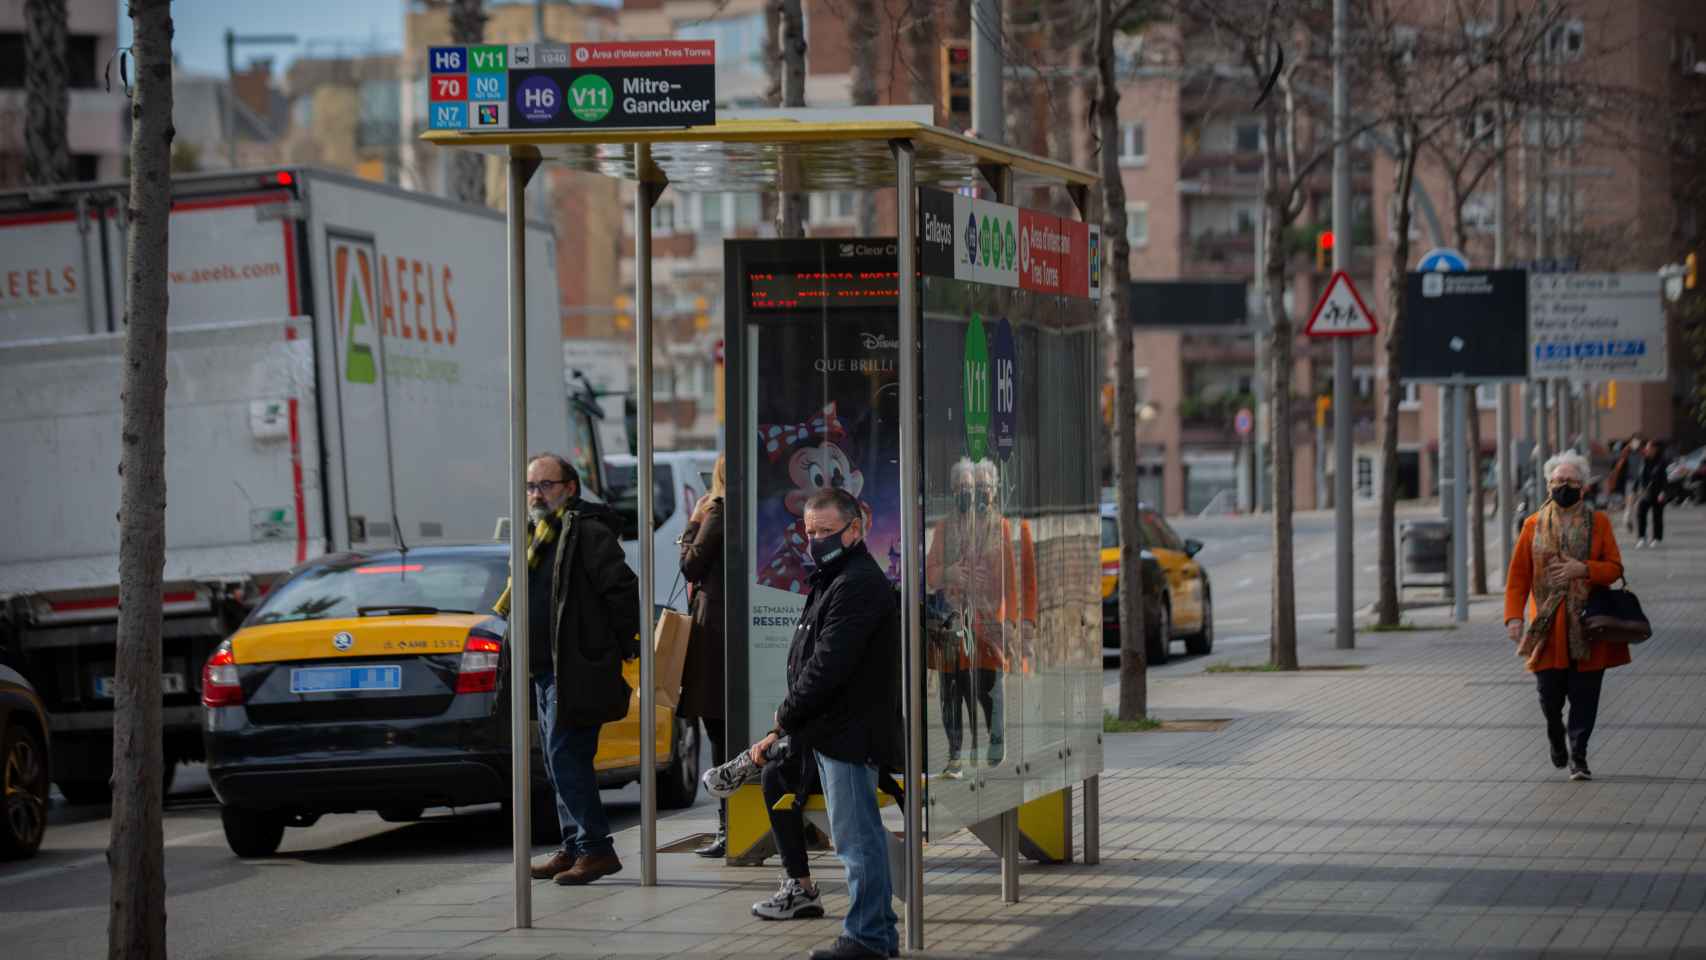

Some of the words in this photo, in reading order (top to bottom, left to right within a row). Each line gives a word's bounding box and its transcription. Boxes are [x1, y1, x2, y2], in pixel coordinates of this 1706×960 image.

[435, 52, 461, 69] H6
[473, 51, 504, 68] V11
[437, 79, 460, 97] 70
[525, 88, 555, 107] H6
[571, 87, 608, 106] V11
[438, 106, 459, 121] N7
[623, 97, 710, 114] Ganduxer
[925, 211, 952, 253] Enllaços
[0, 265, 77, 298] EELS
[169, 261, 281, 285] w.aeels.com
[380, 254, 459, 347] AEELS
[814, 359, 848, 372] QUE
[966, 361, 987, 413] V11
[997, 359, 1013, 413] H6
